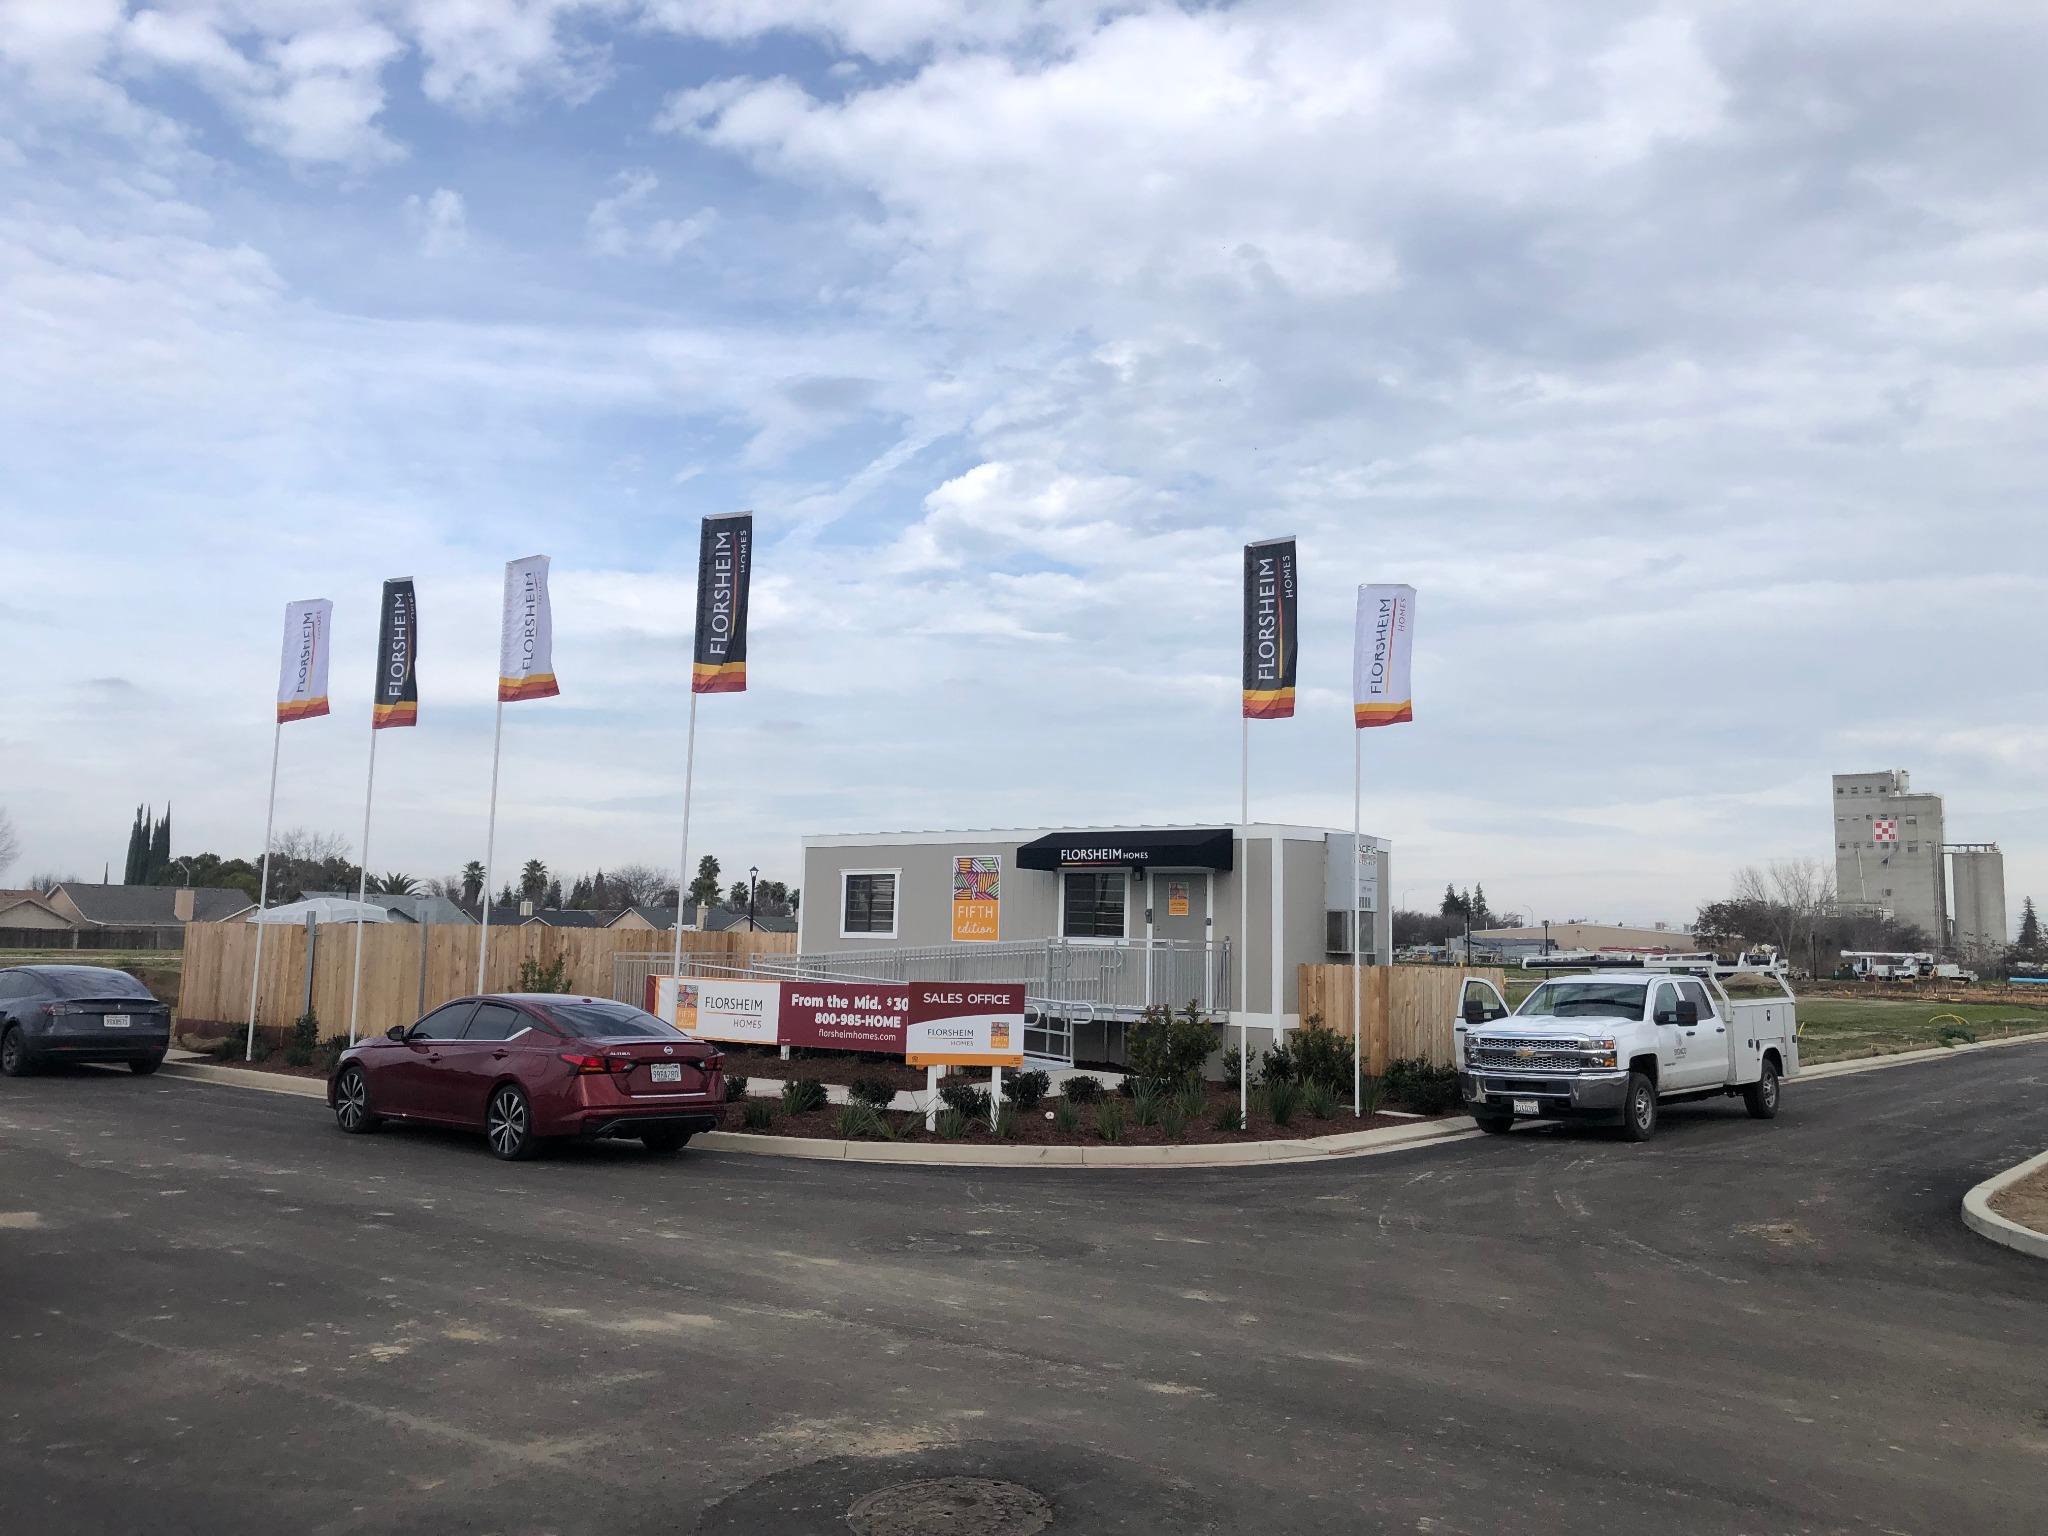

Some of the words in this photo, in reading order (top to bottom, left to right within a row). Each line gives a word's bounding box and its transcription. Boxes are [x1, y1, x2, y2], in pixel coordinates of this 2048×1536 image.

[1282, 555, 1294, 598] HOMES
[709, 531, 731, 655] FLORSHEIM
[522, 572, 536, 670] FLORSHEIM
[1258, 558, 1275, 680] FLORSHEIM
[1398, 597, 1406, 632] HOMES
[388, 593, 406, 696] FLORSHEIM
[1370, 598, 1391, 694] FLORSHEIM
[1060, 848, 1122, 860] FLORSHEIM
[1122, 851, 1149, 859] HOMES
[957, 905, 994, 919] FIFTH
[957, 921, 995, 934] edition
[705, 996, 763, 1011] FLORSHEIM
[791, 993, 824, 1008] From
[827, 994, 849, 1009] the
[854, 995, 882, 1010] Mid.
[923, 992, 963, 1004] SALES
[967, 993, 1011, 1005] OFFICE
[678, 1009, 695, 1018] FIFTH
[814, 1012, 902, 1028] 800-985-HOME
[733, 1018, 762, 1029] HOMES
[818, 1028, 896, 1042] florsheimhomes.com
[927, 1028, 974, 1037] FLORSHEIM
